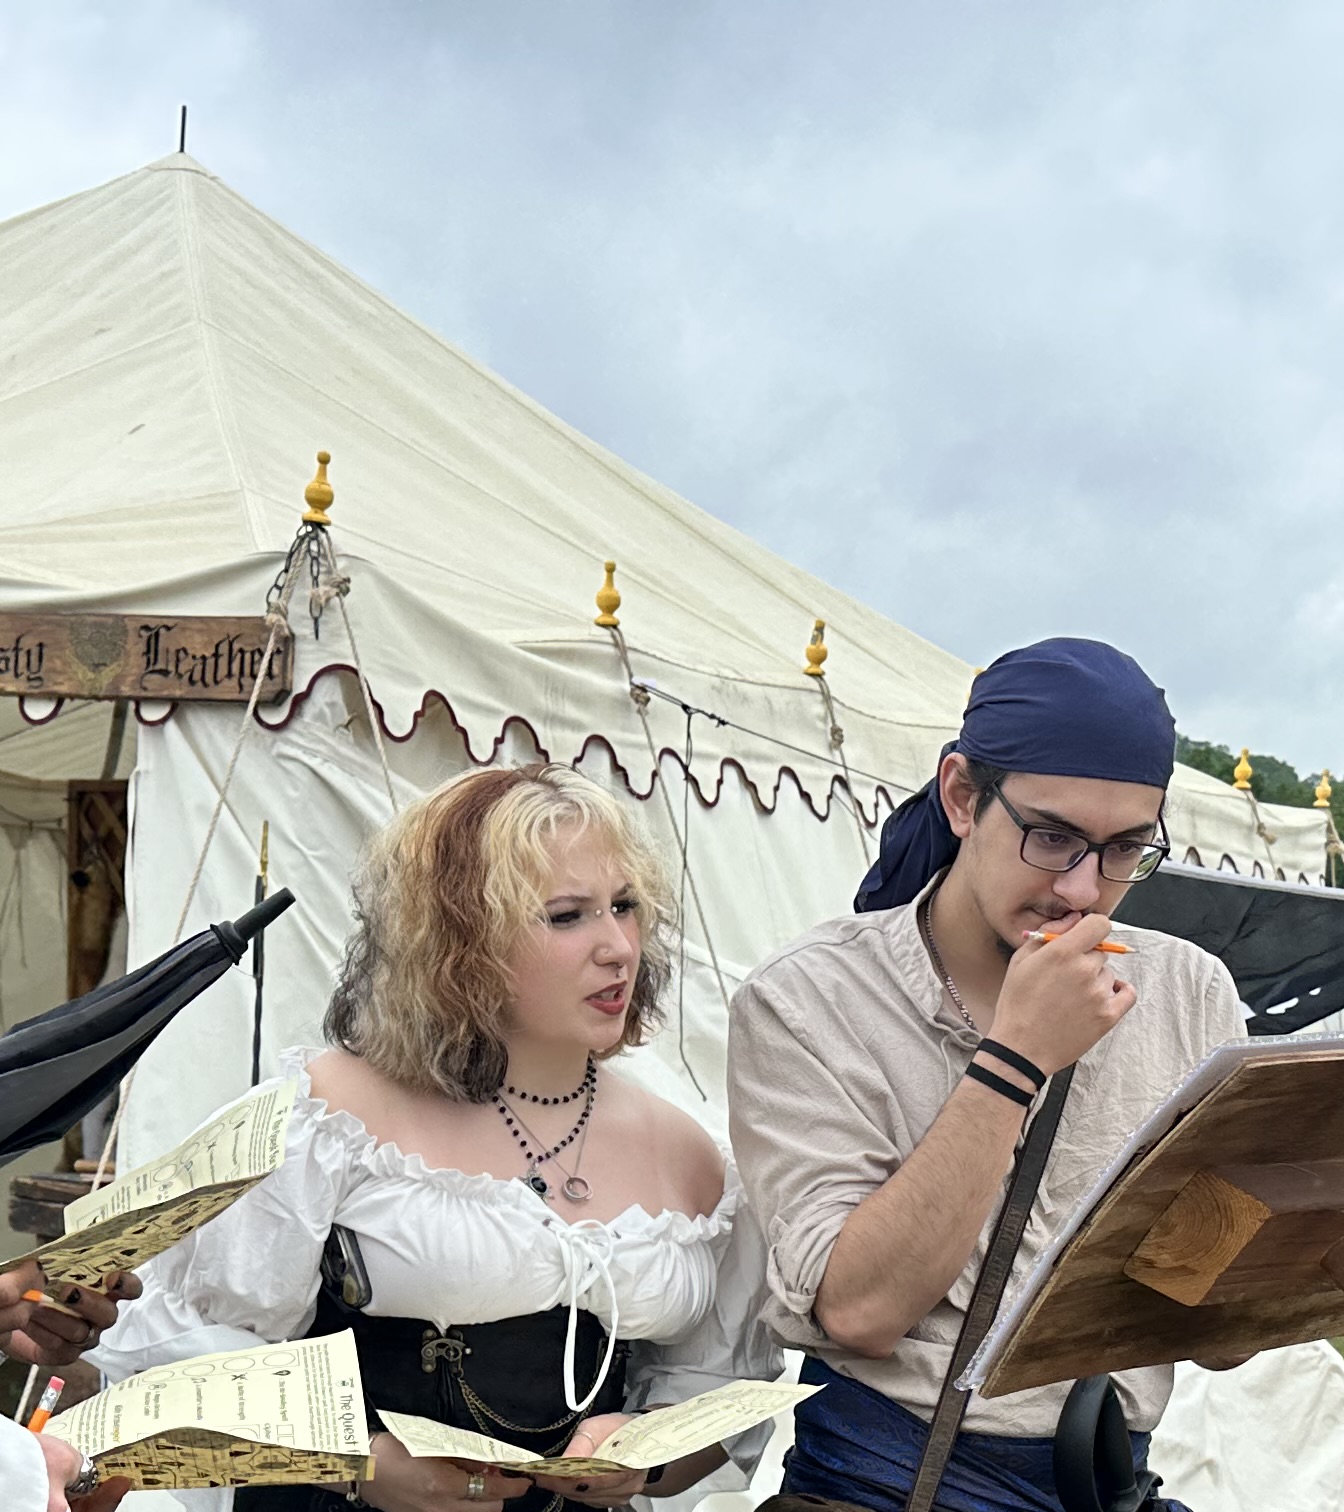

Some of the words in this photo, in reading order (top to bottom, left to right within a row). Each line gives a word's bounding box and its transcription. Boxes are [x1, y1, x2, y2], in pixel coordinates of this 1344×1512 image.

[137, 623, 284, 694] Leather
[339, 1394, 354, 1411] The
[338, 1412, 360, 1446] Quest
